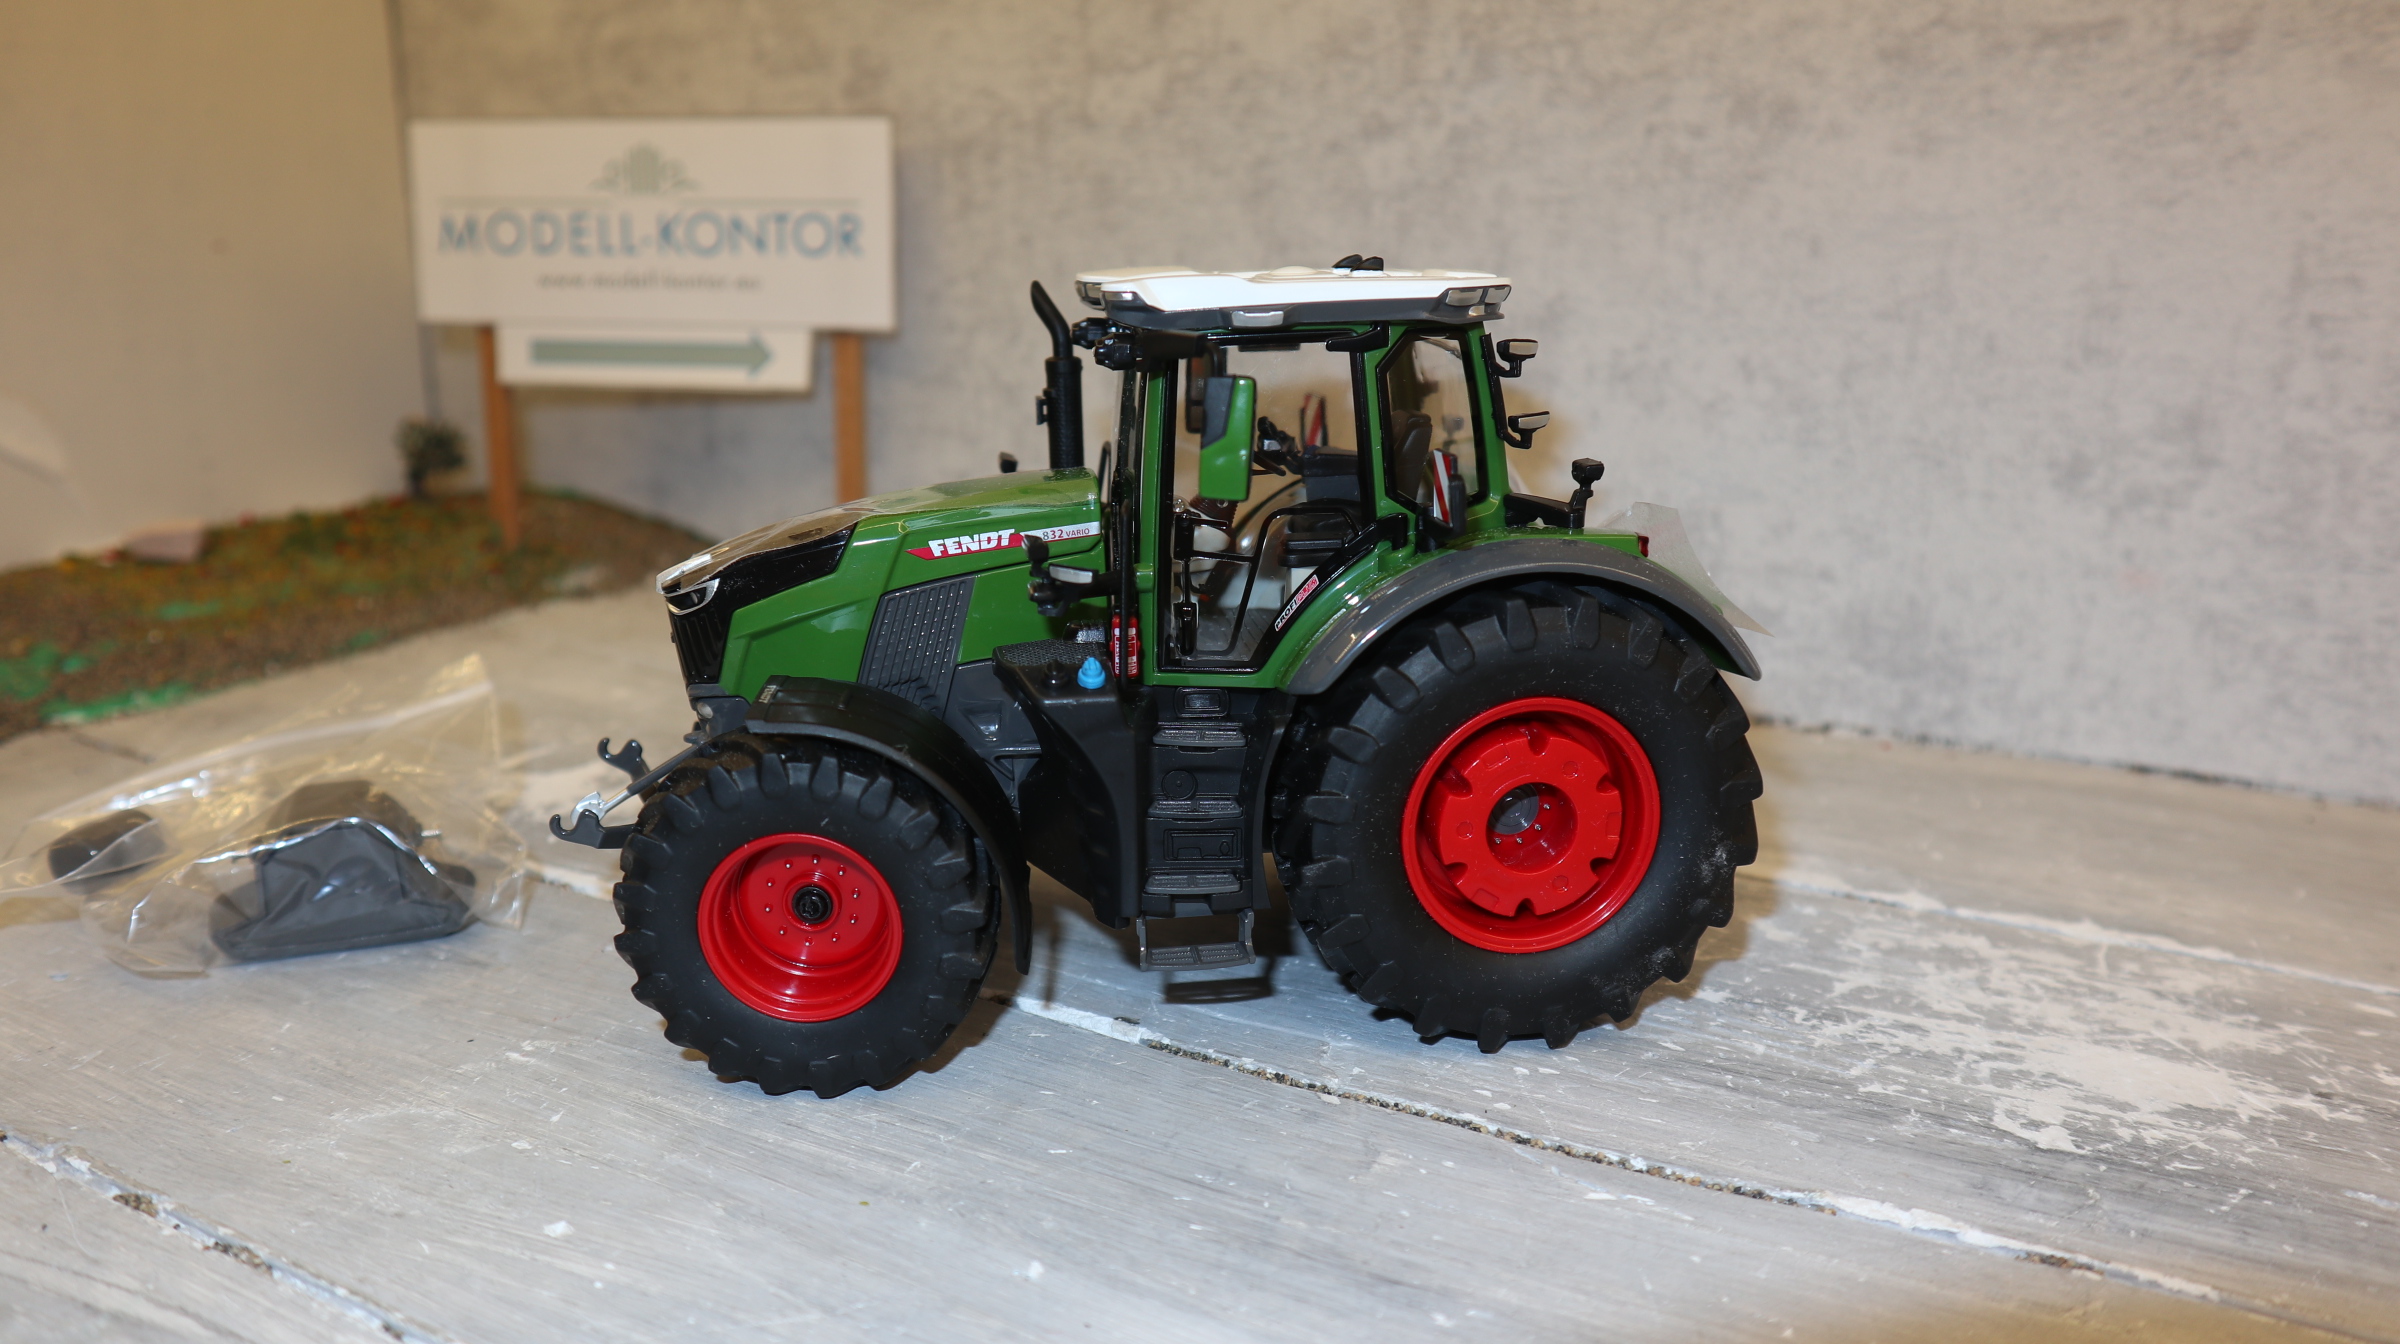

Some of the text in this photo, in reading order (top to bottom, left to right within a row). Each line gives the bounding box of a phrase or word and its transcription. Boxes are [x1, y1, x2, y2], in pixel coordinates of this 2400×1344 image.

[438, 210, 864, 258] MODELL-KONTOR
[928, 528, 1090, 557] FENDT 832 VARIO
